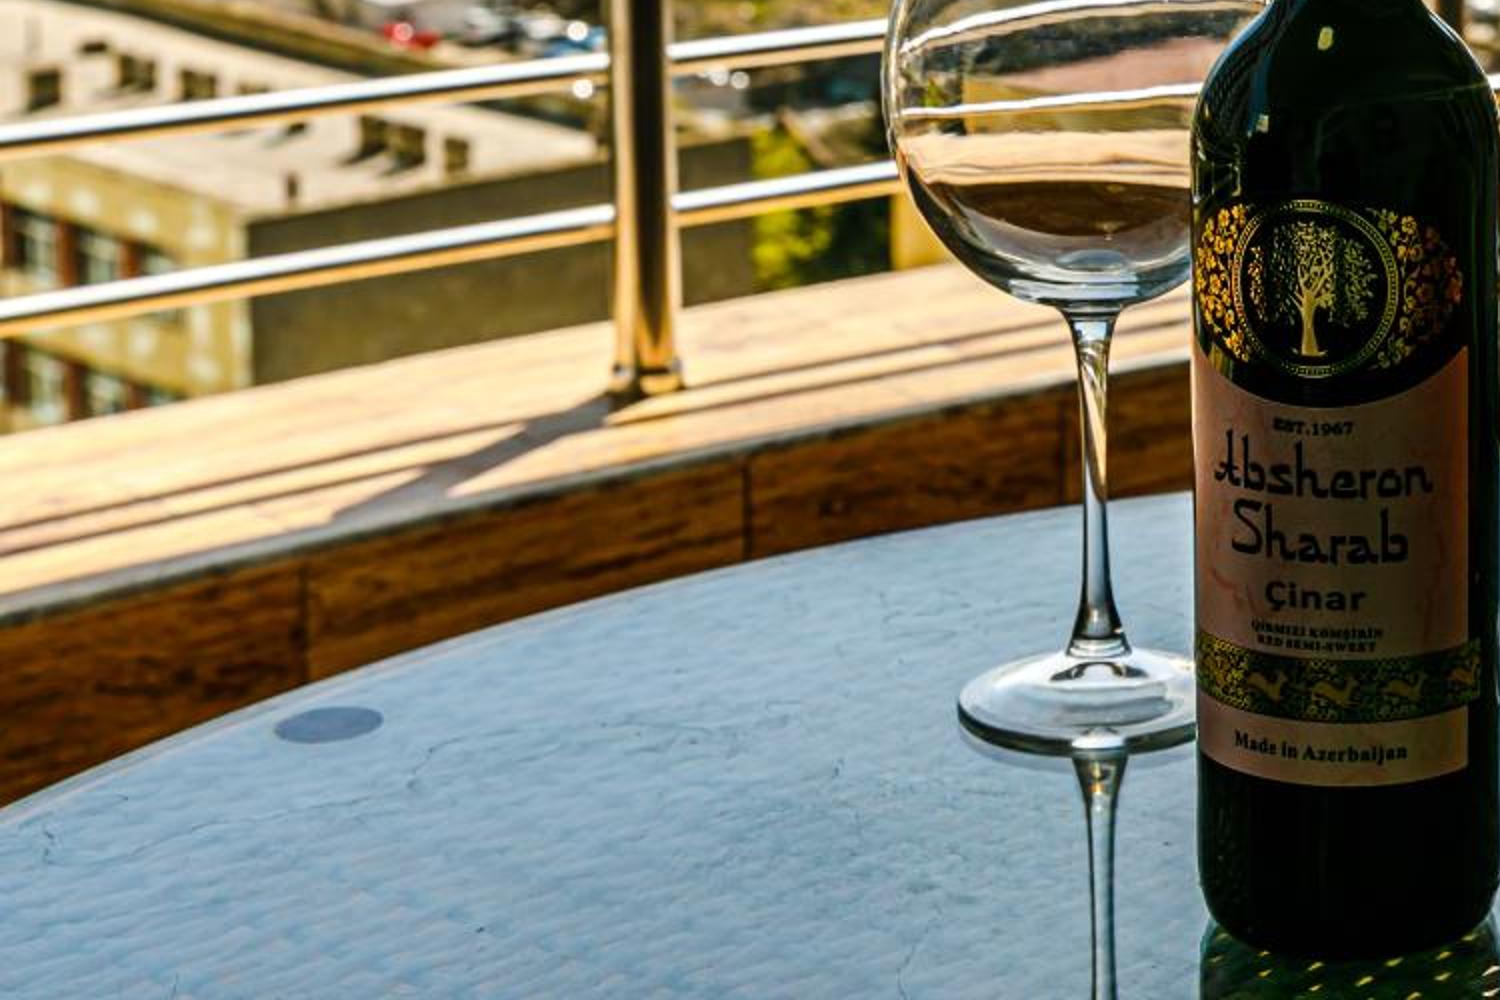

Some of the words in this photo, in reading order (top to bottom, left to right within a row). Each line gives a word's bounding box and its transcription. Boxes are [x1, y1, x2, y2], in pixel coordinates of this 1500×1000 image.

[1231, 498, 1409, 565] Sharab
[1264, 580, 1366, 613] Çinar
[1234, 731, 1277, 755] Made
[1280, 740, 1298, 759] in
[1302, 743, 1408, 764] Azerbaijan
